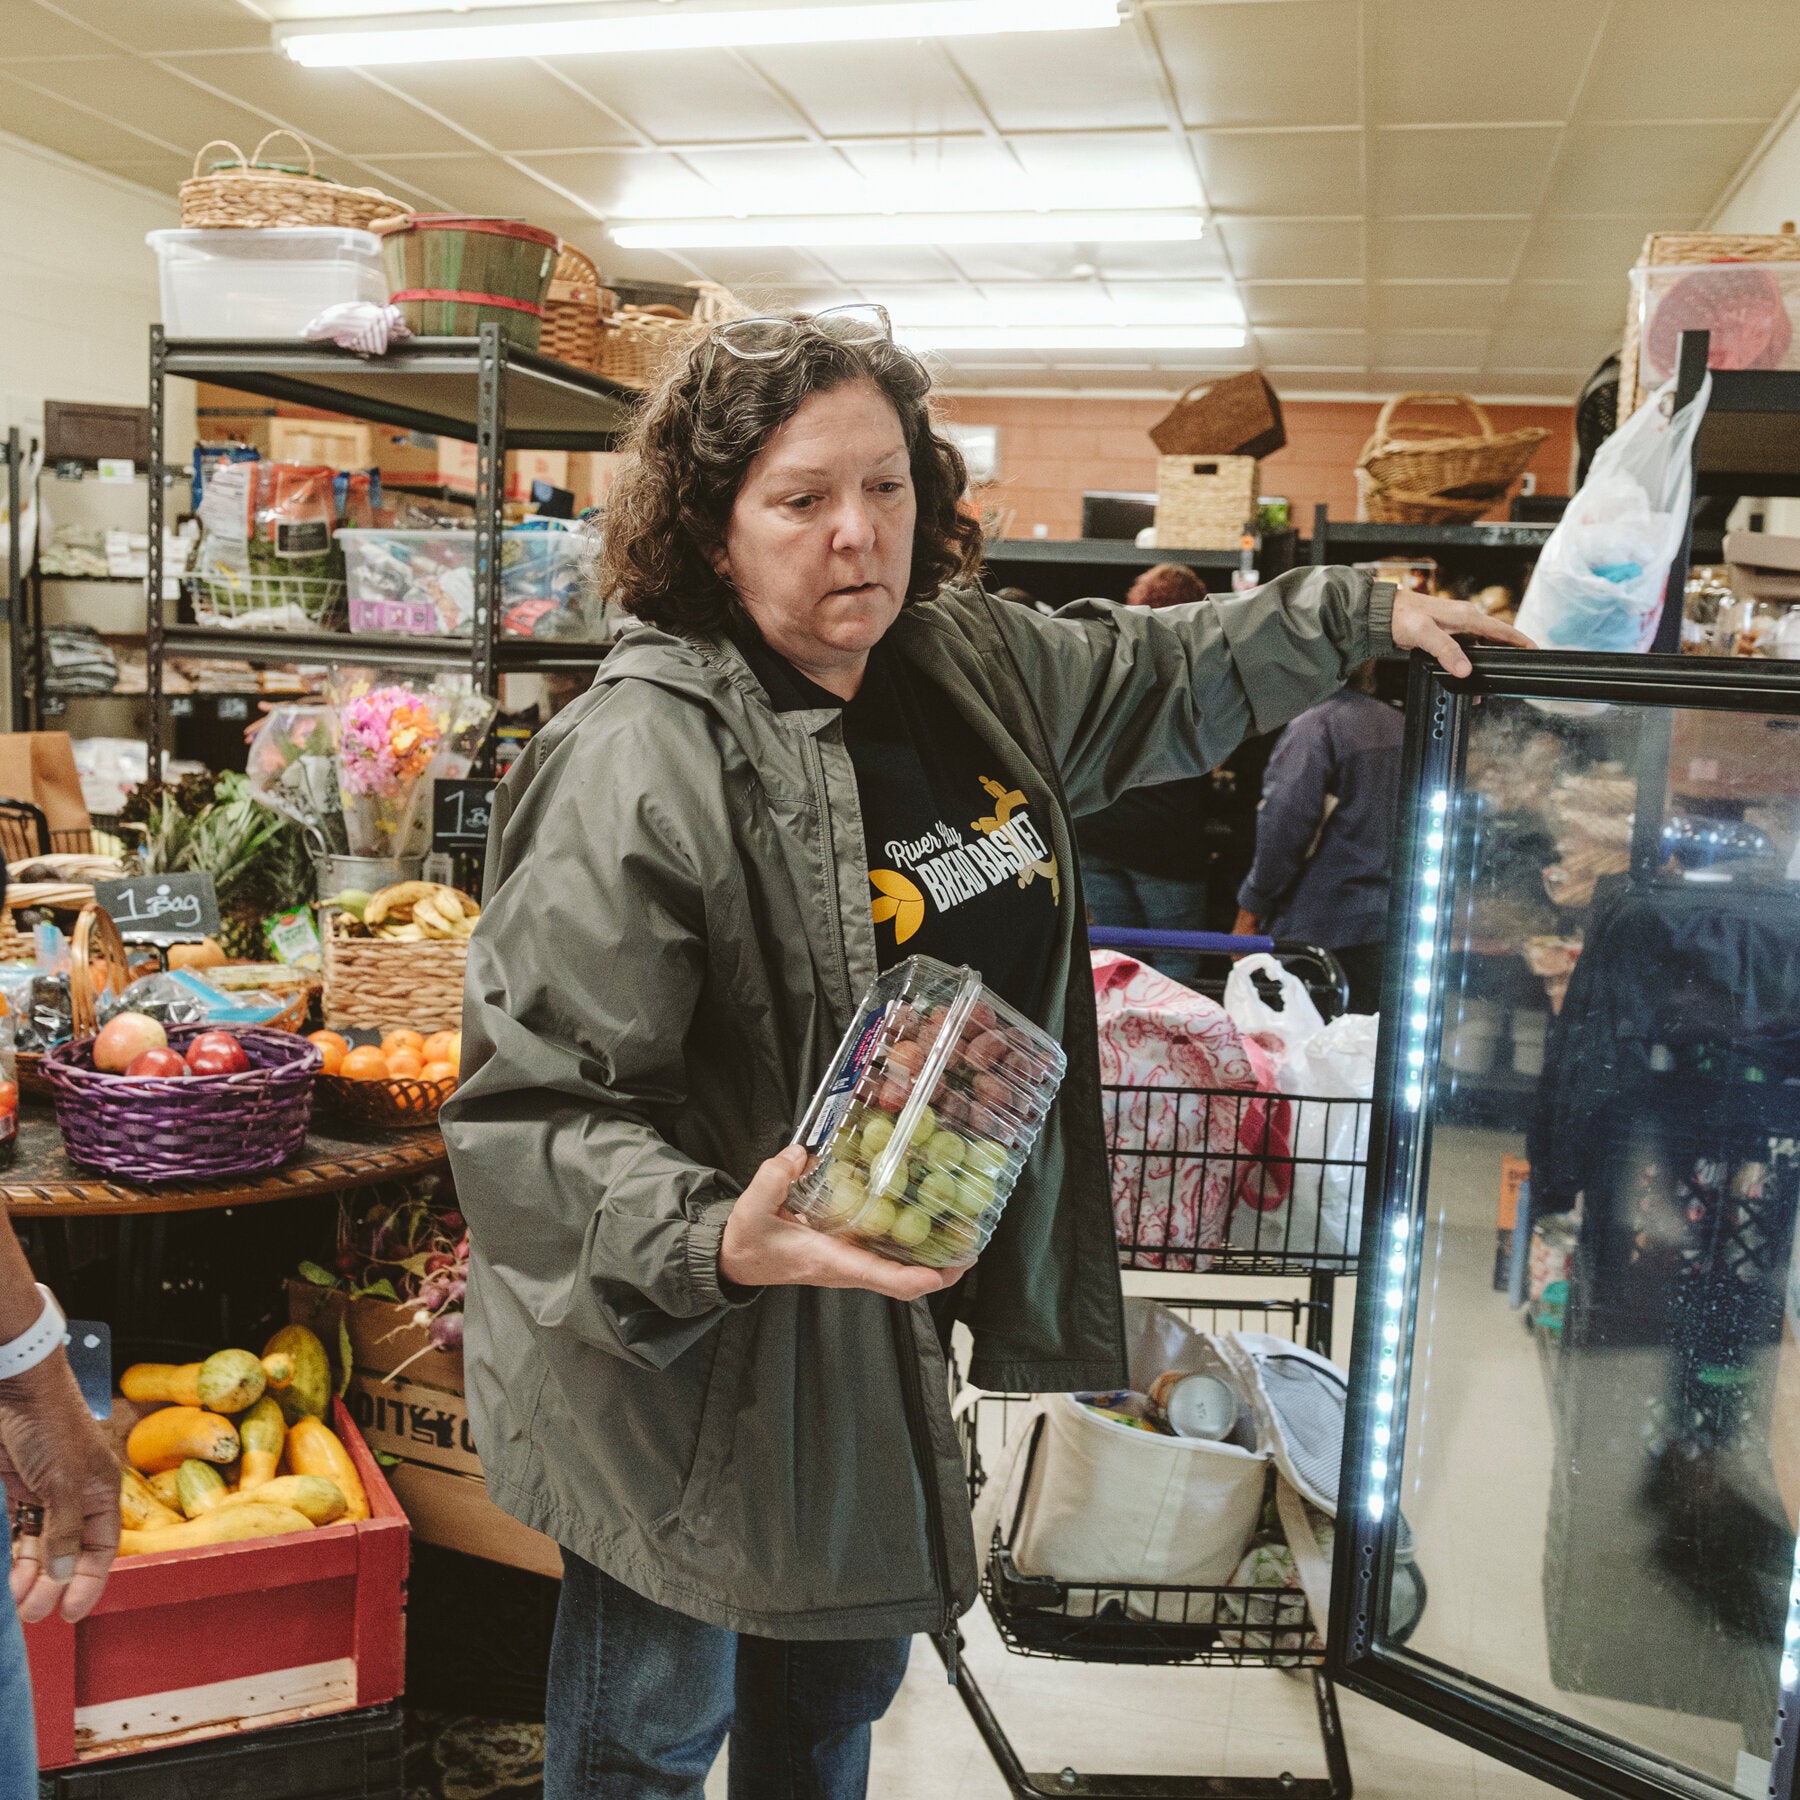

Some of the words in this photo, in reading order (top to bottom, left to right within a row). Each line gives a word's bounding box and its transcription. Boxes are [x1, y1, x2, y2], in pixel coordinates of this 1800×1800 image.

[884, 831, 942, 871] River
[934, 820, 965, 850] City
[915, 848, 988, 913] BREAD
[964, 811, 1048, 886] BASKET
